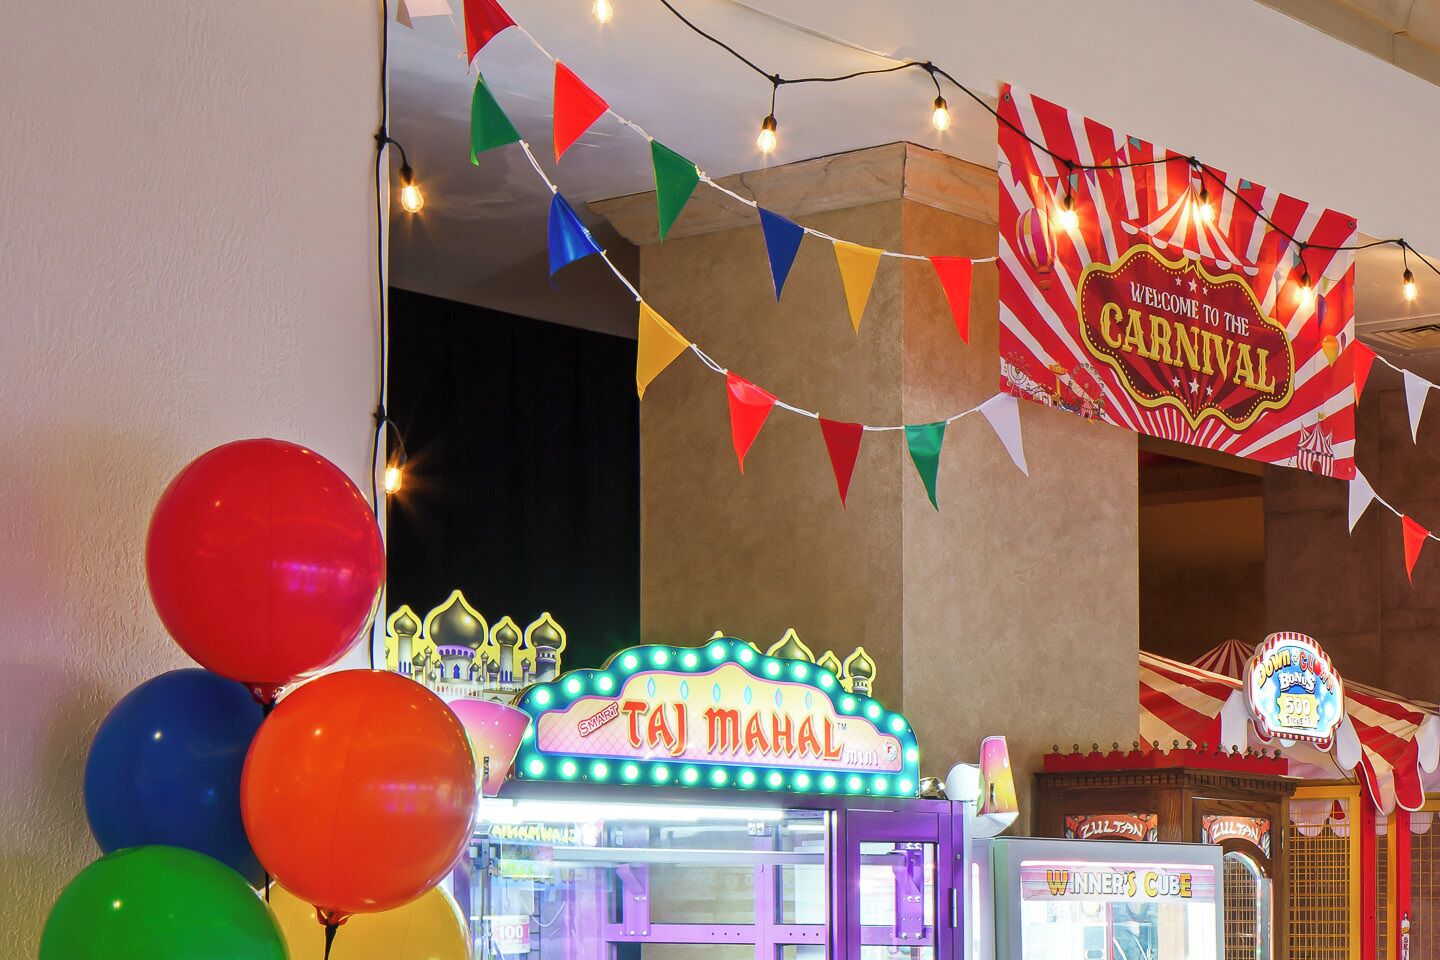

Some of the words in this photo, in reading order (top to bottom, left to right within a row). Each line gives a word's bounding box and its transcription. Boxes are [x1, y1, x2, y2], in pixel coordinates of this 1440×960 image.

[1130, 281, 1199, 319] WELCOME
[1202, 302, 1219, 328] TO
[1223, 310, 1250, 337] THE
[1100, 301, 1276, 395] CARNIVAL
[577, 702, 619, 738] SMART
[1285, 696, 1311, 717] 500
[622, 700, 687, 757] TAJ
[704, 706, 845, 761] MAHAL
[1080, 819, 1145, 839] ZULTAN
[1210, 820, 1260, 841] ZULTAN
[1046, 869, 1136, 898] WINNER'S
[1143, 871, 1193, 898] CUBE
[494, 925, 524, 939] 100
